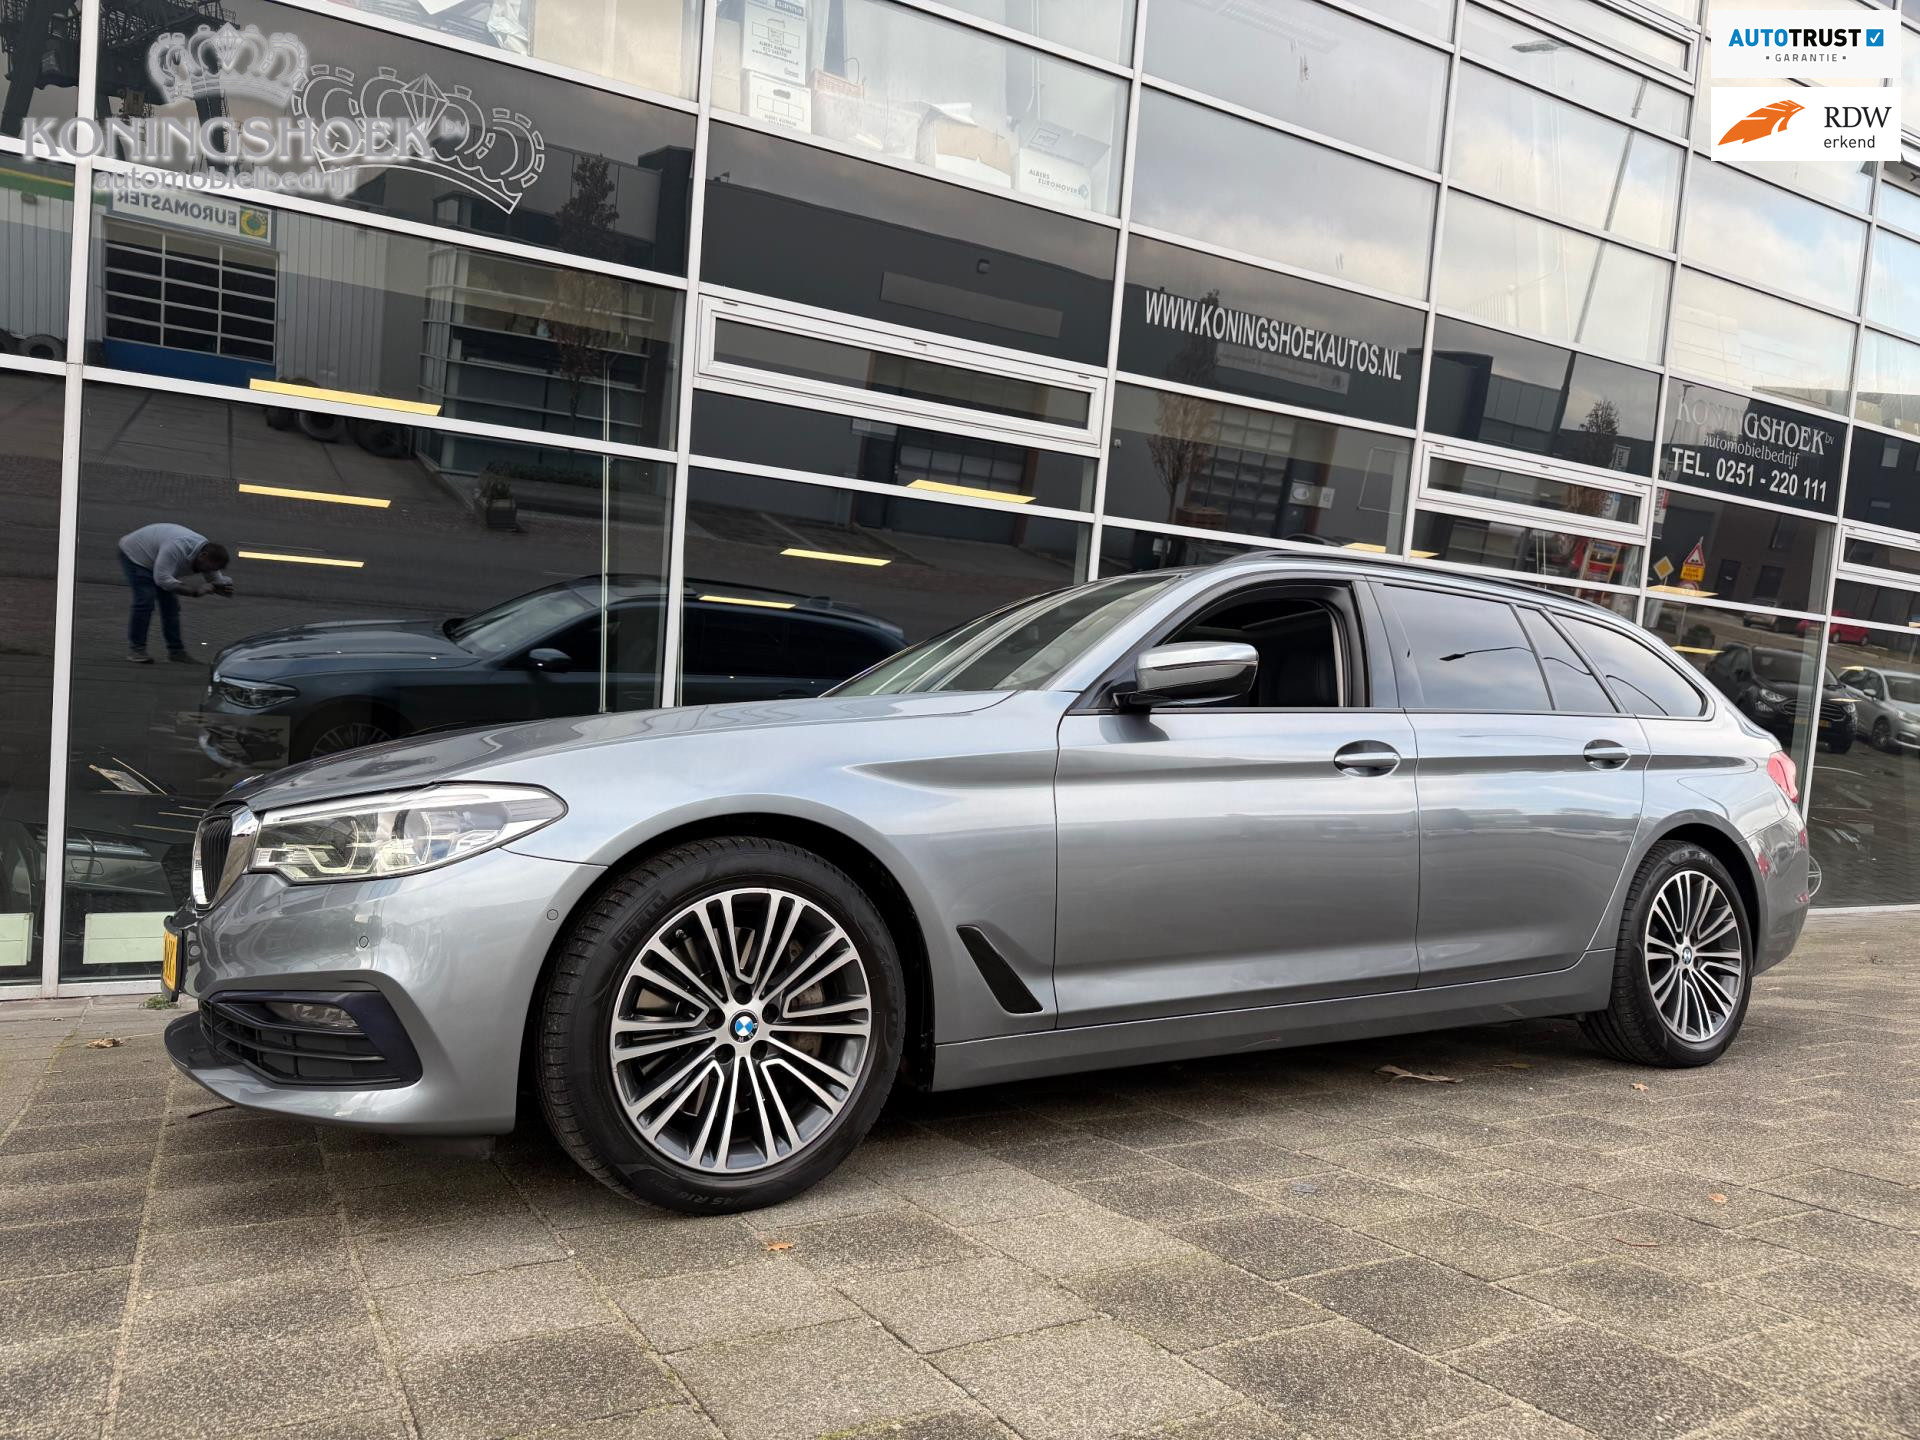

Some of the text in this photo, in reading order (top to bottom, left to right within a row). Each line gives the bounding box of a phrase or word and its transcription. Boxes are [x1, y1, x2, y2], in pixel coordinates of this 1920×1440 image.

[1028, 168, 1051, 180] ALBERS
[1144, 289, 1403, 381] WWW.KONINGSHOEKAUTOS.NL
[1676, 397, 1835, 456] KONINGSHOEK bv
[1703, 432, 1801, 471] automobielbedrijf
[1671, 447, 1710, 478] TEL.
[1716, 457, 1754, 487] 0251
[1769, 469, 1798, 497] 220
[1803, 477, 1827, 503] 111
